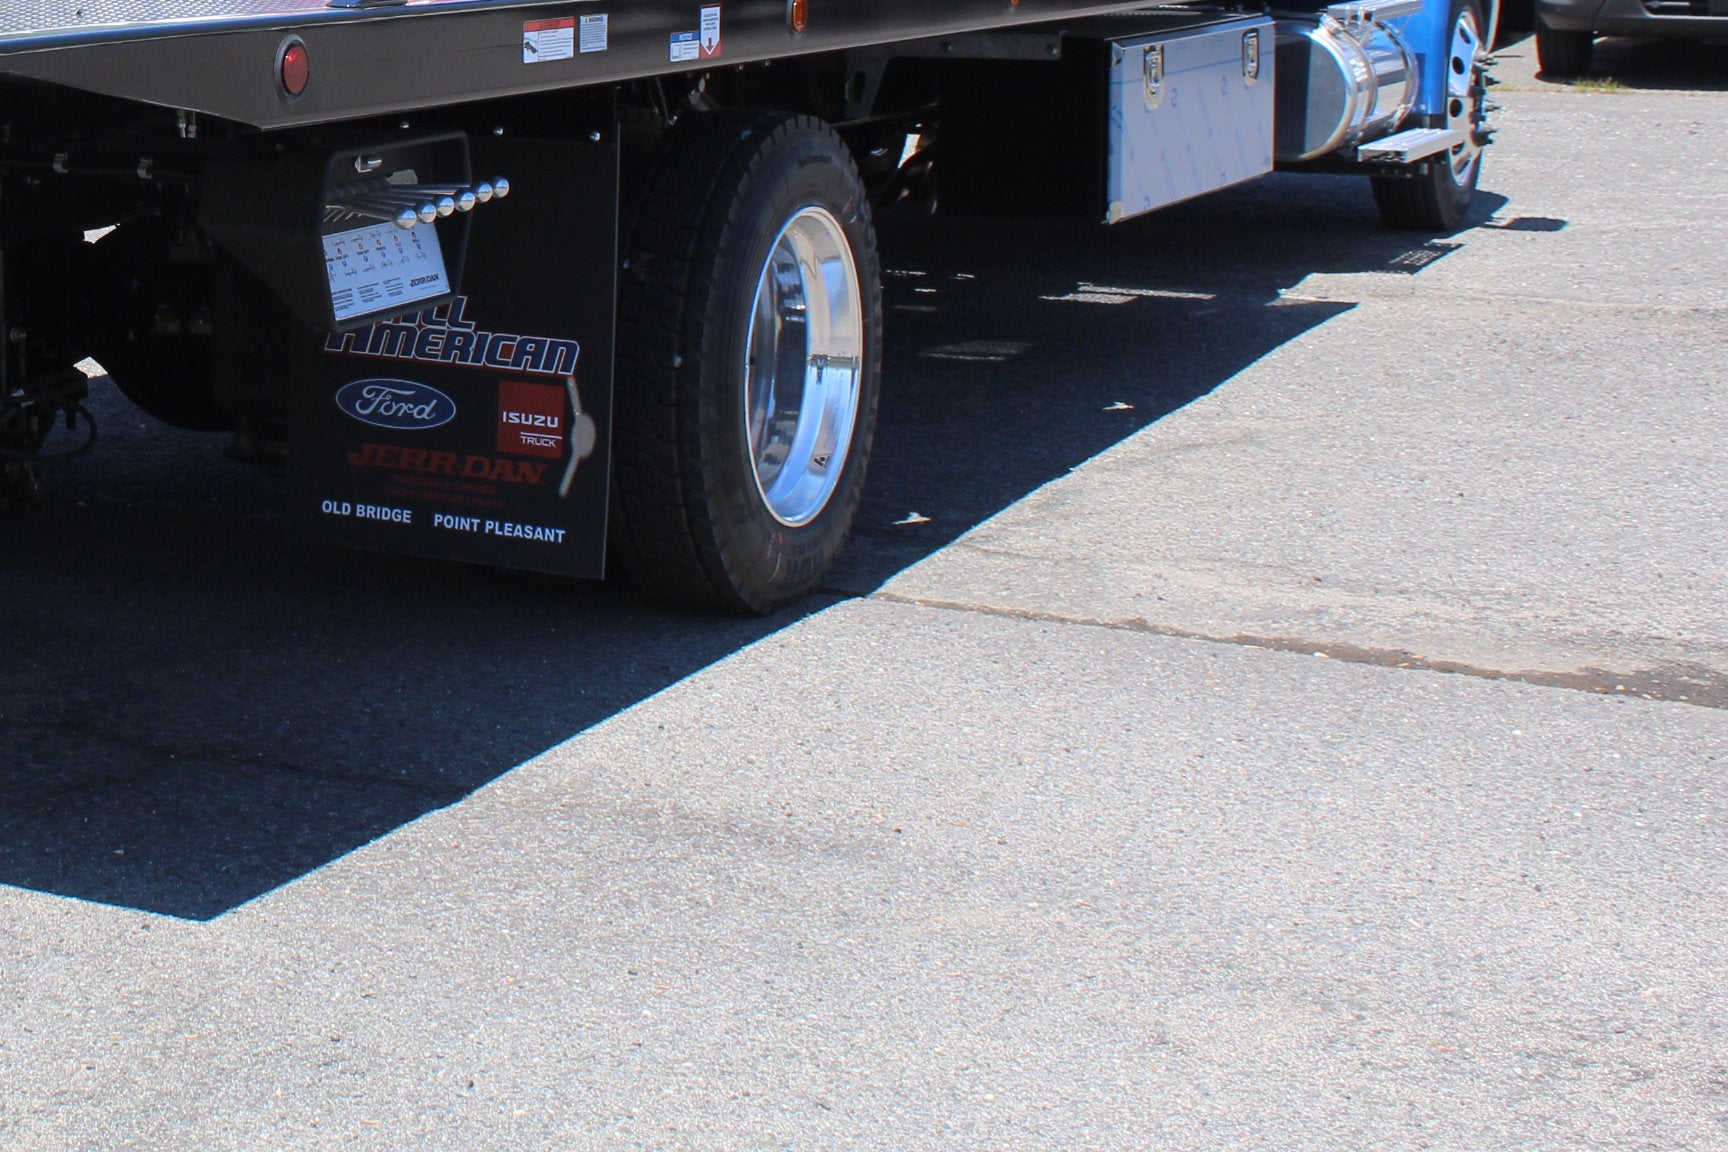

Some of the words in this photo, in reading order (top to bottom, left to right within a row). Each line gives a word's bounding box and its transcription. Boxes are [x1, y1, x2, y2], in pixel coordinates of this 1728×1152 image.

[355, 385, 438, 420] Ford
[502, 411, 559, 428] ISUZU
[521, 435, 556, 448] TRUCK
[322, 500, 351, 516] OLD
[356, 504, 412, 524] BRIDGE
[433, 513, 480, 533] POINT
[485, 519, 566, 544] PLEASANT
